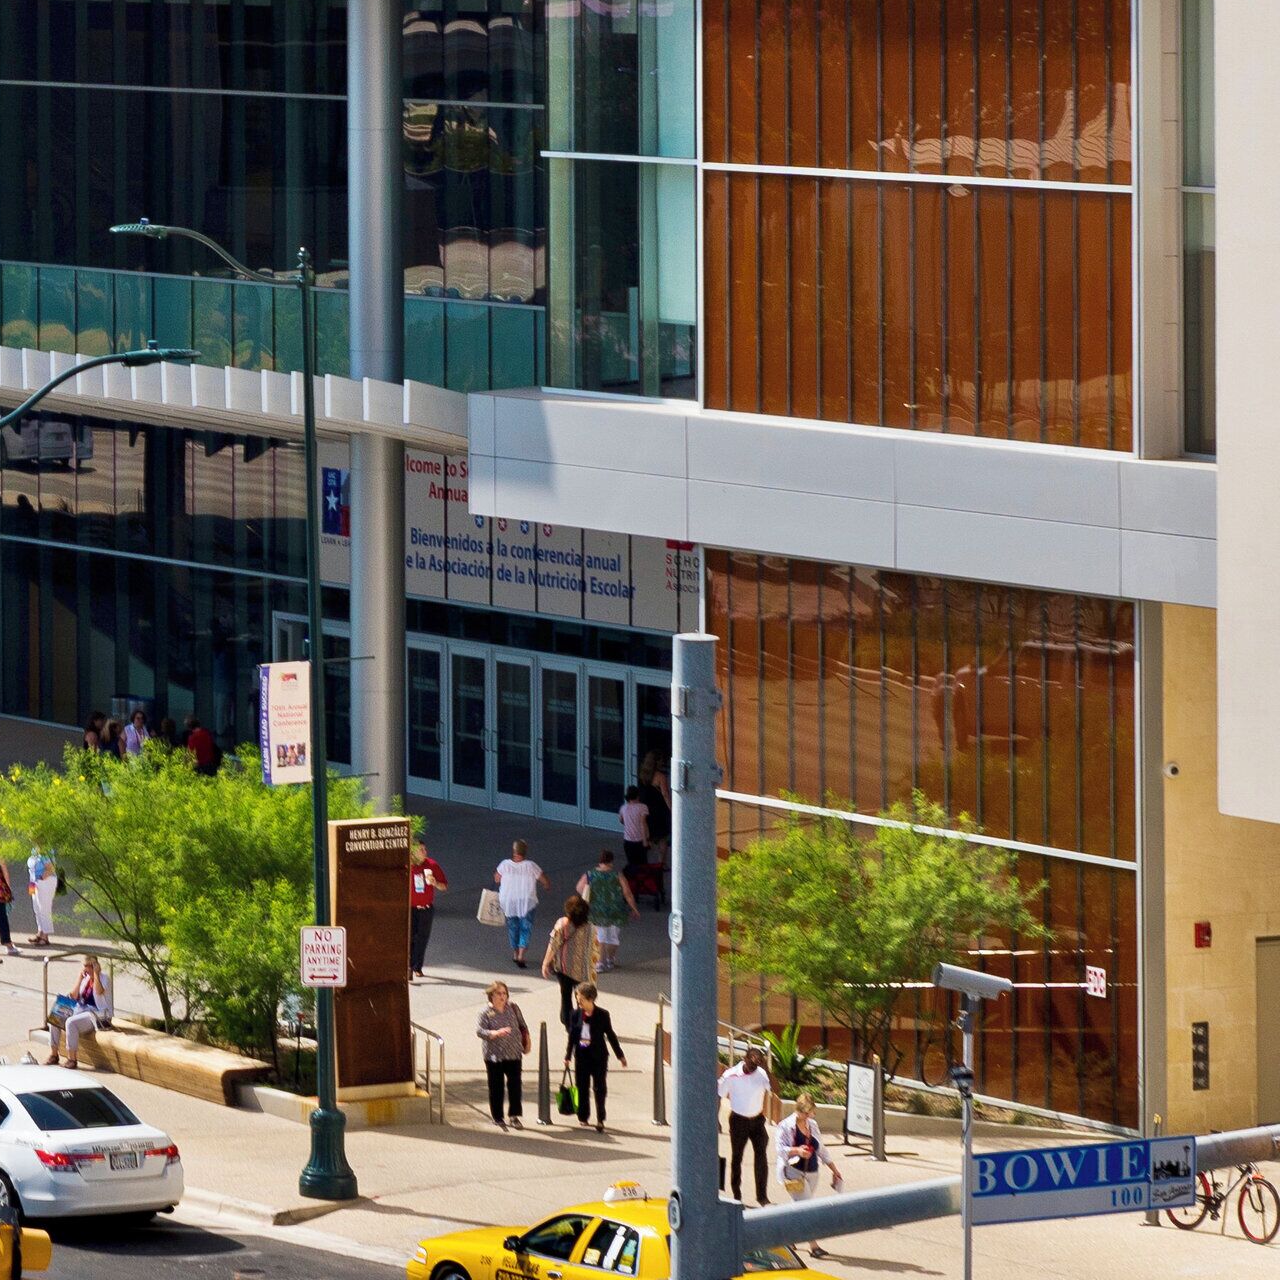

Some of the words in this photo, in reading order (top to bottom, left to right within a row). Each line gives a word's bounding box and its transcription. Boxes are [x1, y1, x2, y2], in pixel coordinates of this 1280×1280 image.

[406, 454, 440, 475] lcome
[428, 482, 468, 503] Annua
[410, 527, 483, 554] Bienvenidos
[486, 542, 494, 554] a
[497, 538, 508, 557] la
[511, 542, 581, 567] conferencia
[586, 554, 621, 573] anual
[665, 553, 700, 569] SCHO
[416, 552, 426, 569] la
[429, 554, 491, 579] Asociación
[497, 563, 512, 582] de
[515, 565, 525, 584] la
[528, 567, 586, 594] Nutrición
[591, 577, 637, 600] Escolar
[665, 567, 700, 581] NUTRIT
[349, 829, 370, 841] HENRY
[345, 840, 384, 852] CONVENTION
[384, 837, 408, 850] CENTER
[314, 930, 332, 942] NO
[304, 943, 342, 955] PARKING
[972, 1145, 1147, 1193] BOWIE
[1110, 1186, 1143, 1207] 100
